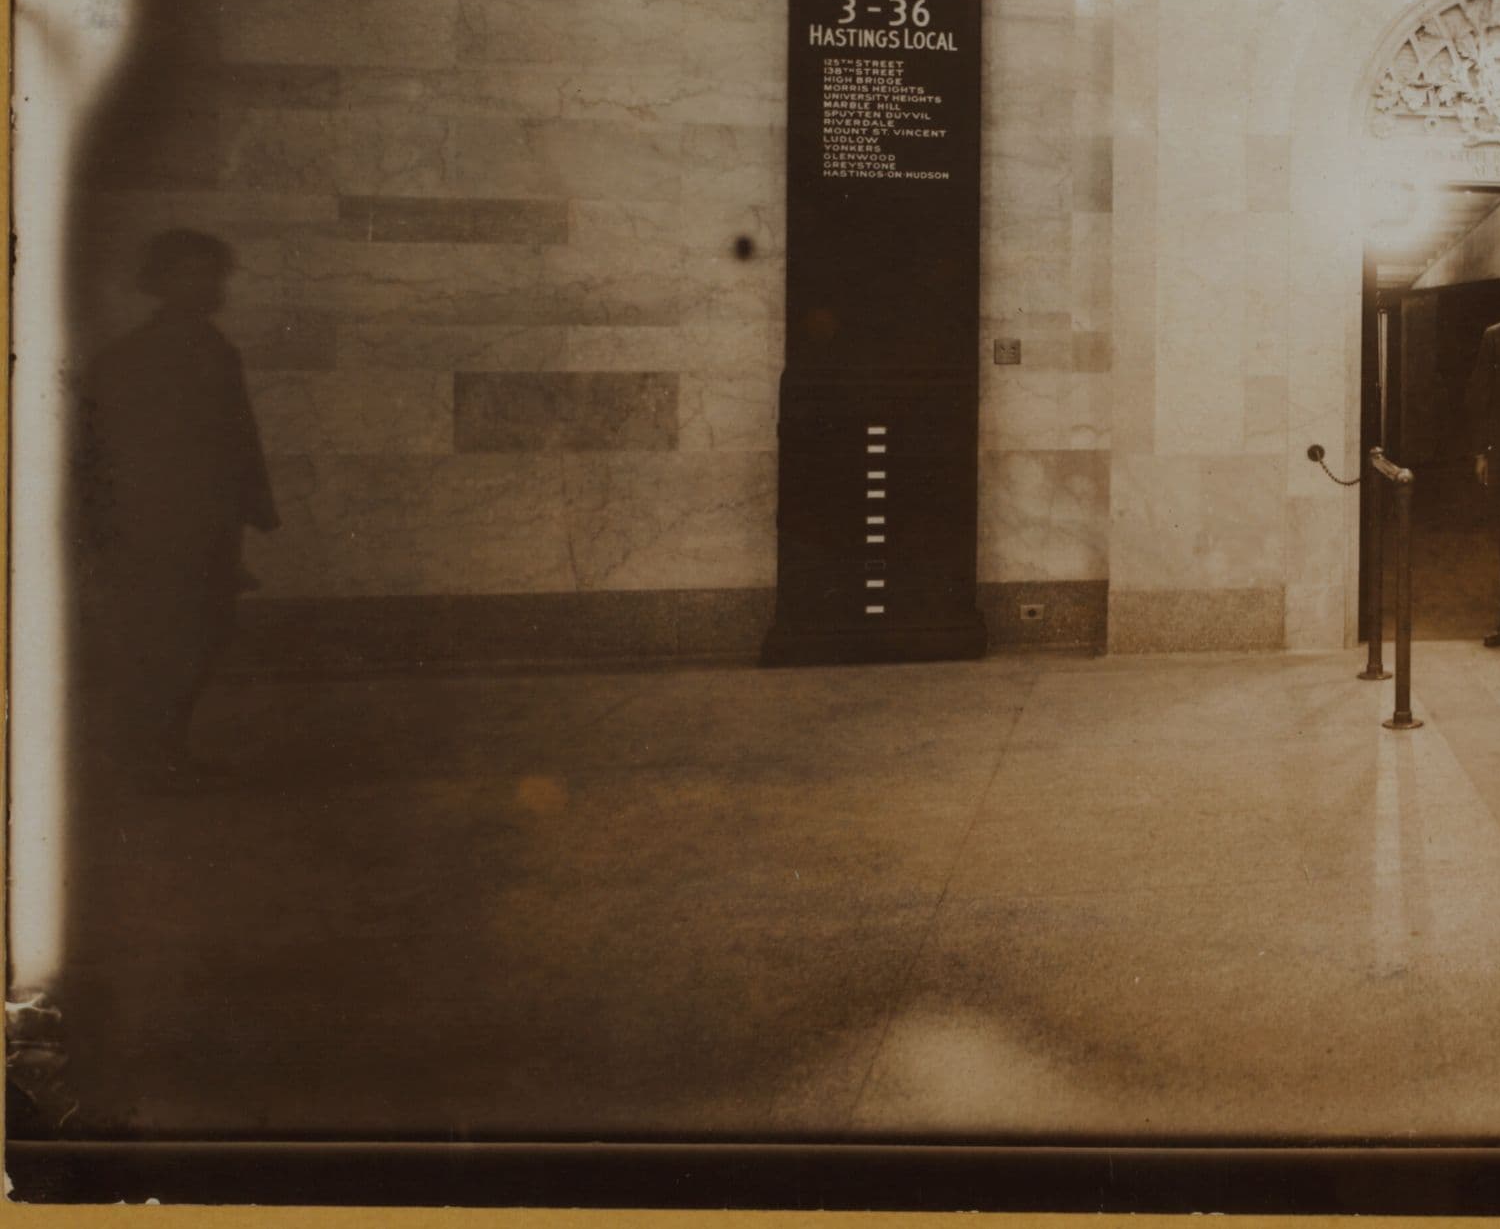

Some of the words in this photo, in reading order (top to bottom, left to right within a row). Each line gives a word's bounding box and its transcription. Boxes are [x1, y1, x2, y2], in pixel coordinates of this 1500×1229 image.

[809, 24, 900, 50] HASTINGS
[904, 28, 958, 52] LOCAL
[855, 60, 904, 68] STREET
[855, 68, 904, 76] STREET
[824, 76, 852, 84] HIGH
[856, 77, 902, 85] BRIDGE
[824, 84, 869, 92] MORRIS
[872, 86, 924, 94] HEIGHTS
[824, 93, 889, 101] UNIVERSITY
[892, 95, 942, 103] HEIGHTS
[824, 101, 870, 109] MARBLE
[877, 103, 900, 111] HILL
[886, 112, 931, 120] DUYVIL
[824, 119, 895, 127] RIVERDALE
[893, 129, 946, 137] VINCENT
[824, 153, 896, 161] GLENWOOD
[824, 161, 896, 170] GREYSTONE
